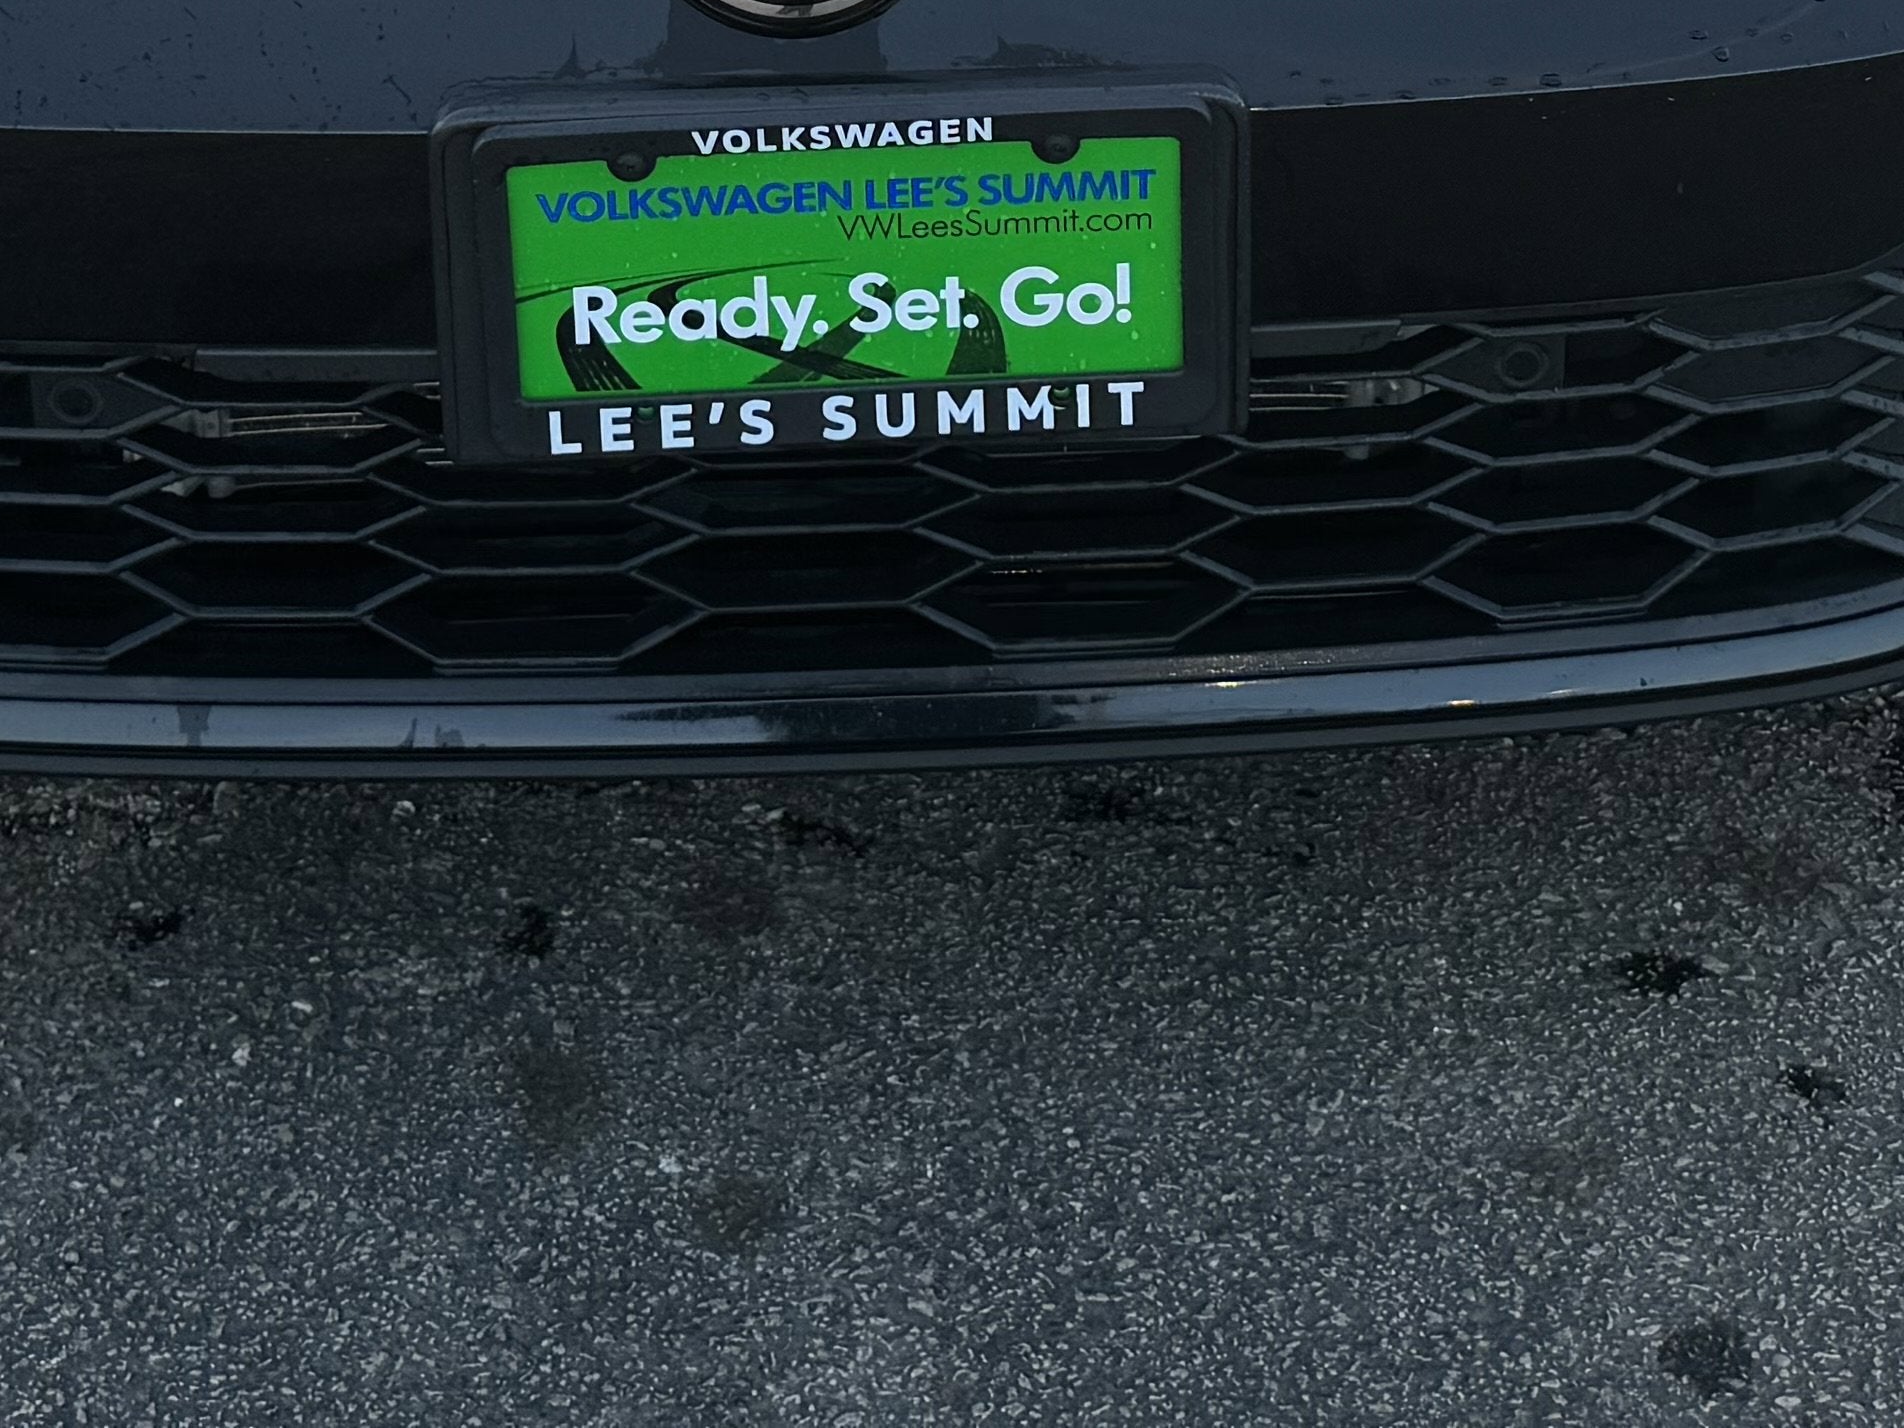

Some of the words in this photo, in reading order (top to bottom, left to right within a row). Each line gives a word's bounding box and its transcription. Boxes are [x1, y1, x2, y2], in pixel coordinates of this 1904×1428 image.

[692, 116, 995, 156] VOLKSWAGEN
[535, 180, 853, 223] VOLKSWAGEN
[864, 174, 970, 209] LEE'S
[978, 169, 1157, 204] SUMMIT
[837, 209, 1153, 242] VWLeesSummit.com
[571, 275, 829, 352] Ready.
[847, 272, 980, 335] Set.
[999, 262, 1133, 328] Go!
[548, 399, 776, 456] LEE'S
[822, 381, 1146, 441] SUMMIT
